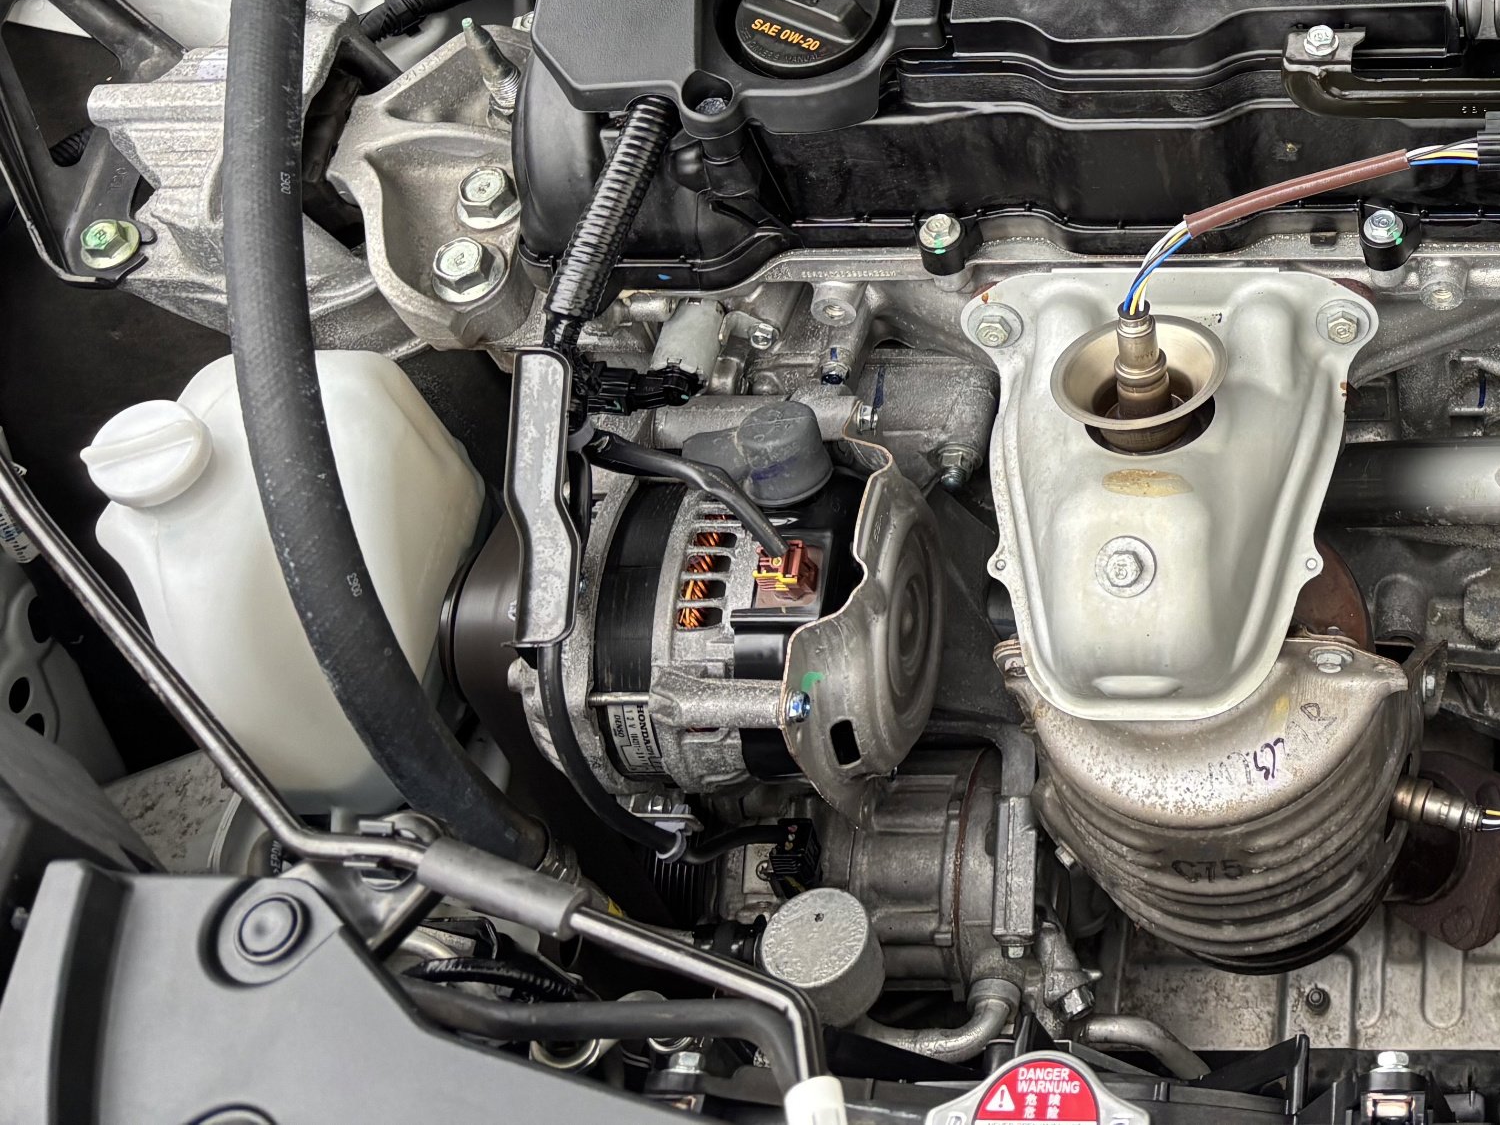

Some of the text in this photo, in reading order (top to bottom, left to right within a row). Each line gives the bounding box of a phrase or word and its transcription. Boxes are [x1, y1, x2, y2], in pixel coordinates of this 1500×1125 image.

[751, 18, 821, 51] SAE 0W-20
[613, 714, 625, 738] DENSO
[637, 704, 652, 746] HONDA
[1018, 1067, 1070, 1080] DANGER
[1016, 1081, 1081, 1094] WARNUNG
